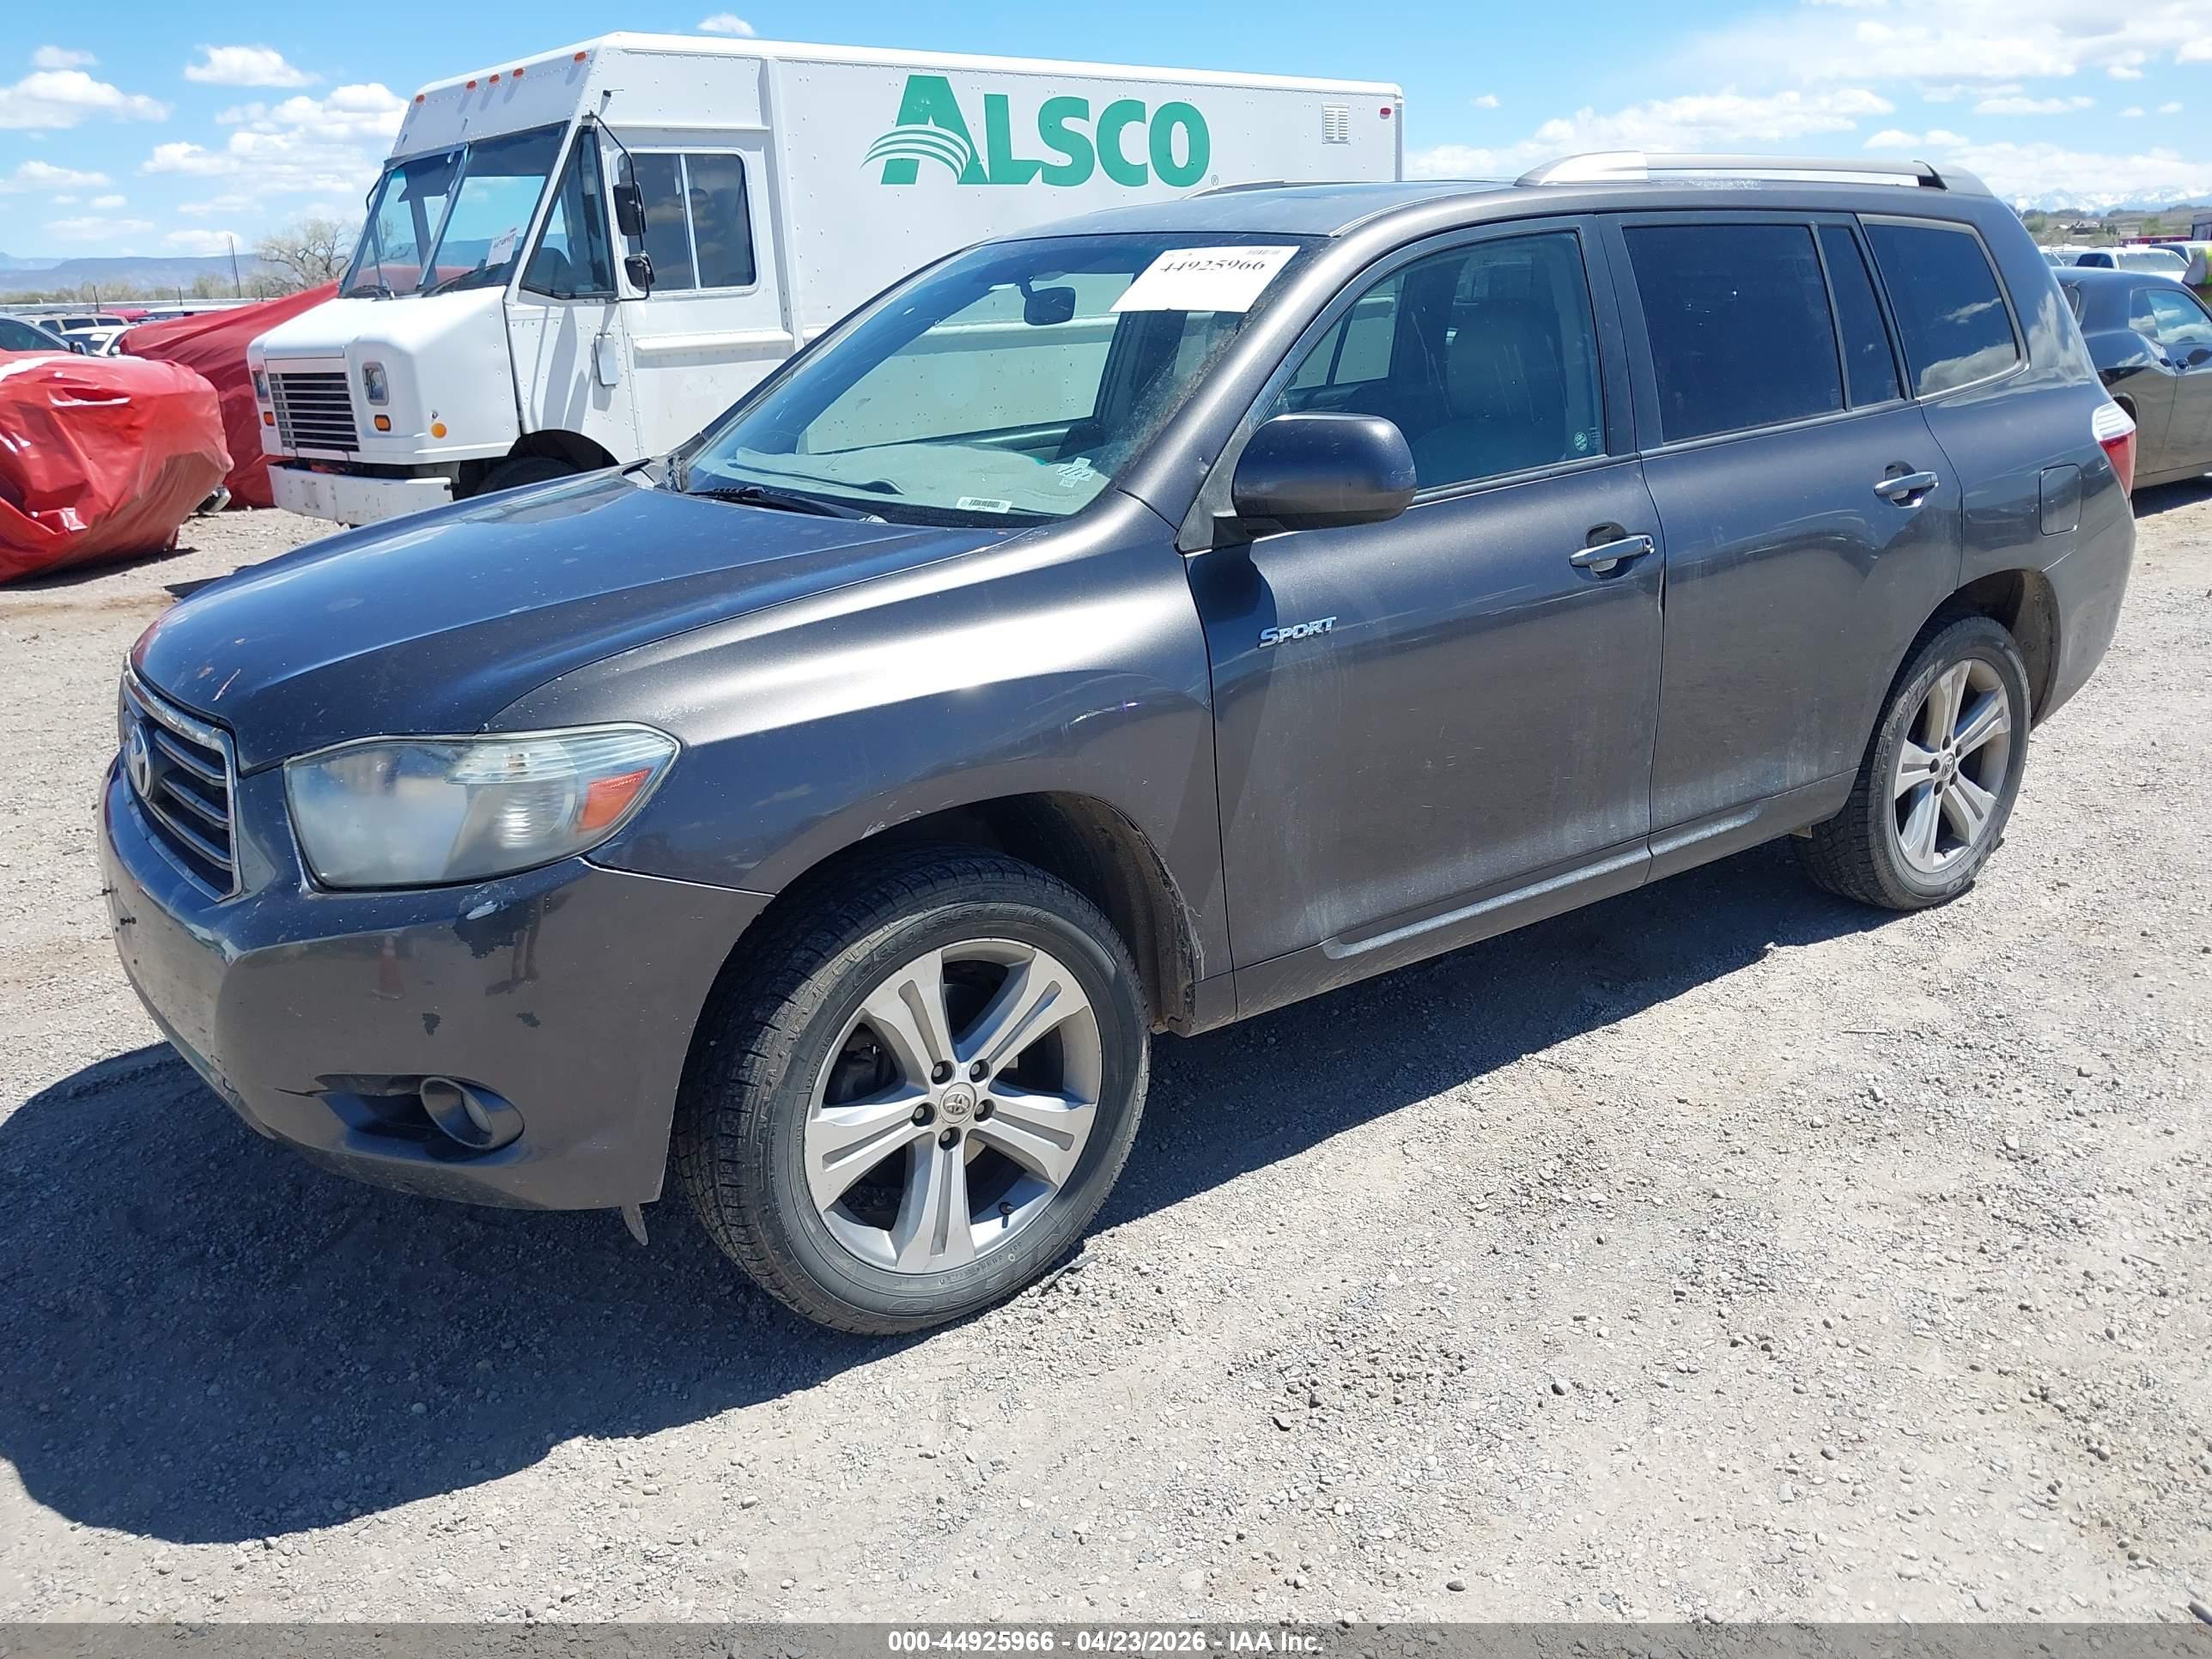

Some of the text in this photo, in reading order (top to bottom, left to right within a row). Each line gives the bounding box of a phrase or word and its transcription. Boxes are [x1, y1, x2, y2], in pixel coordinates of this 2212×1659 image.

[879, 75, 1210, 187] ALSCO
[1160, 259, 1265, 272] 44925966
[1258, 616, 1337, 647] SPORT
